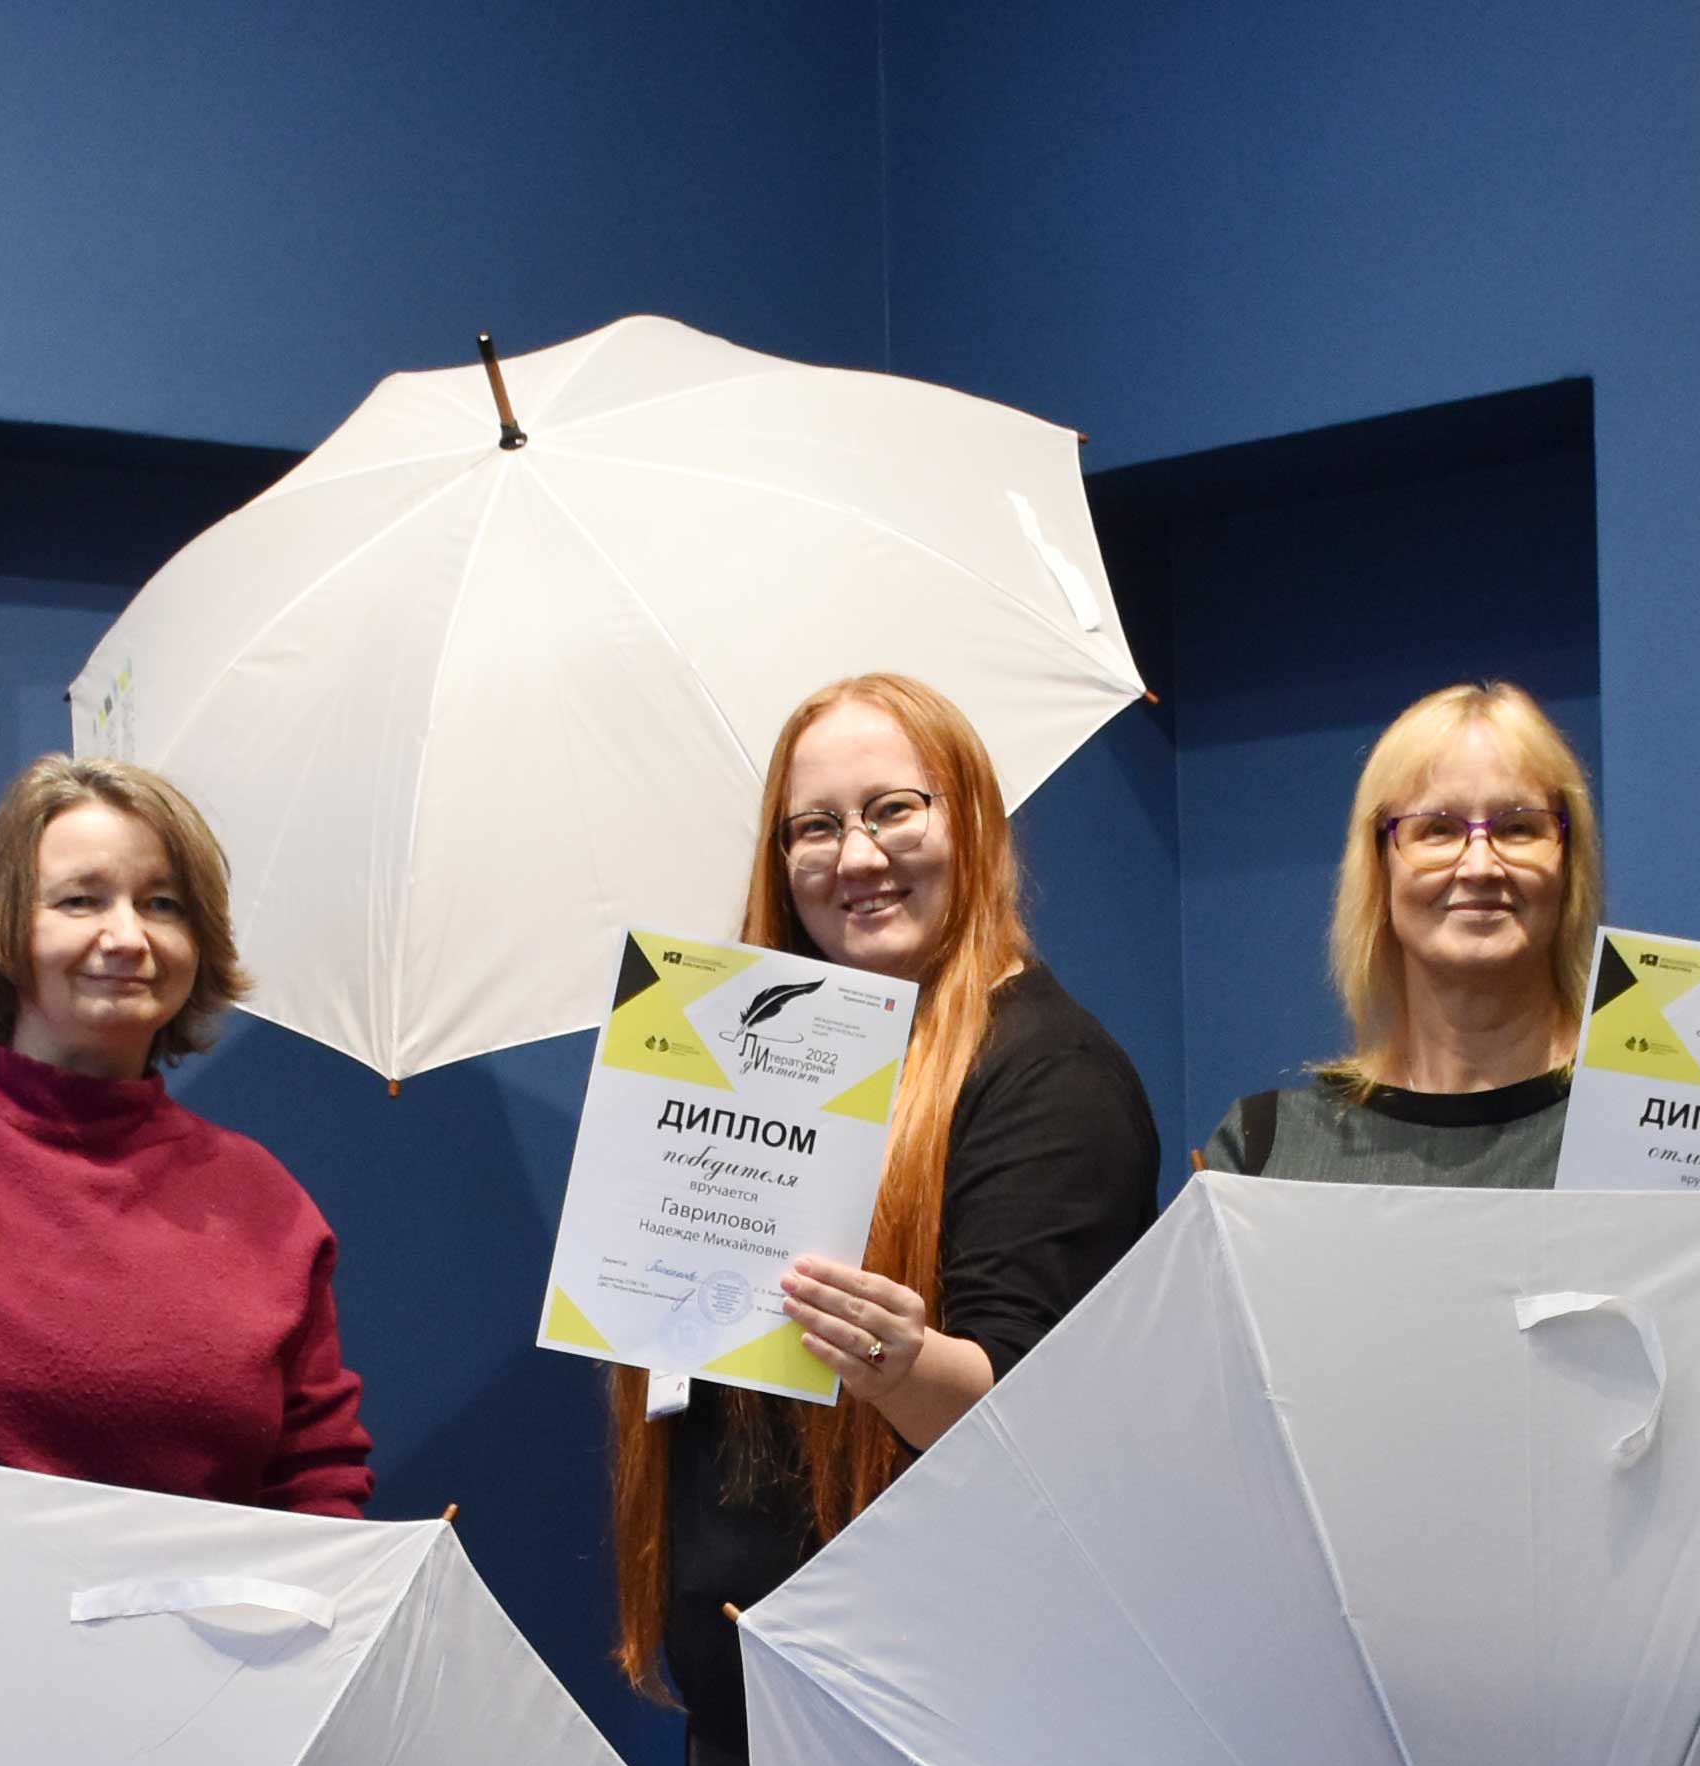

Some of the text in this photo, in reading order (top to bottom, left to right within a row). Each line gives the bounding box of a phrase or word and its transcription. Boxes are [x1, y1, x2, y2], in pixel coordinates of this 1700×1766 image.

[805, 1048, 839, 1066] 2022
[657, 1099, 817, 1155] ДИПЛОМ
[663, 1145, 799, 1188] победителя
[690, 1180, 758, 1202] вручается
[661, 1196, 776, 1236] Гавриловой
[639, 1218, 789, 1260] Надежде Михайловне
